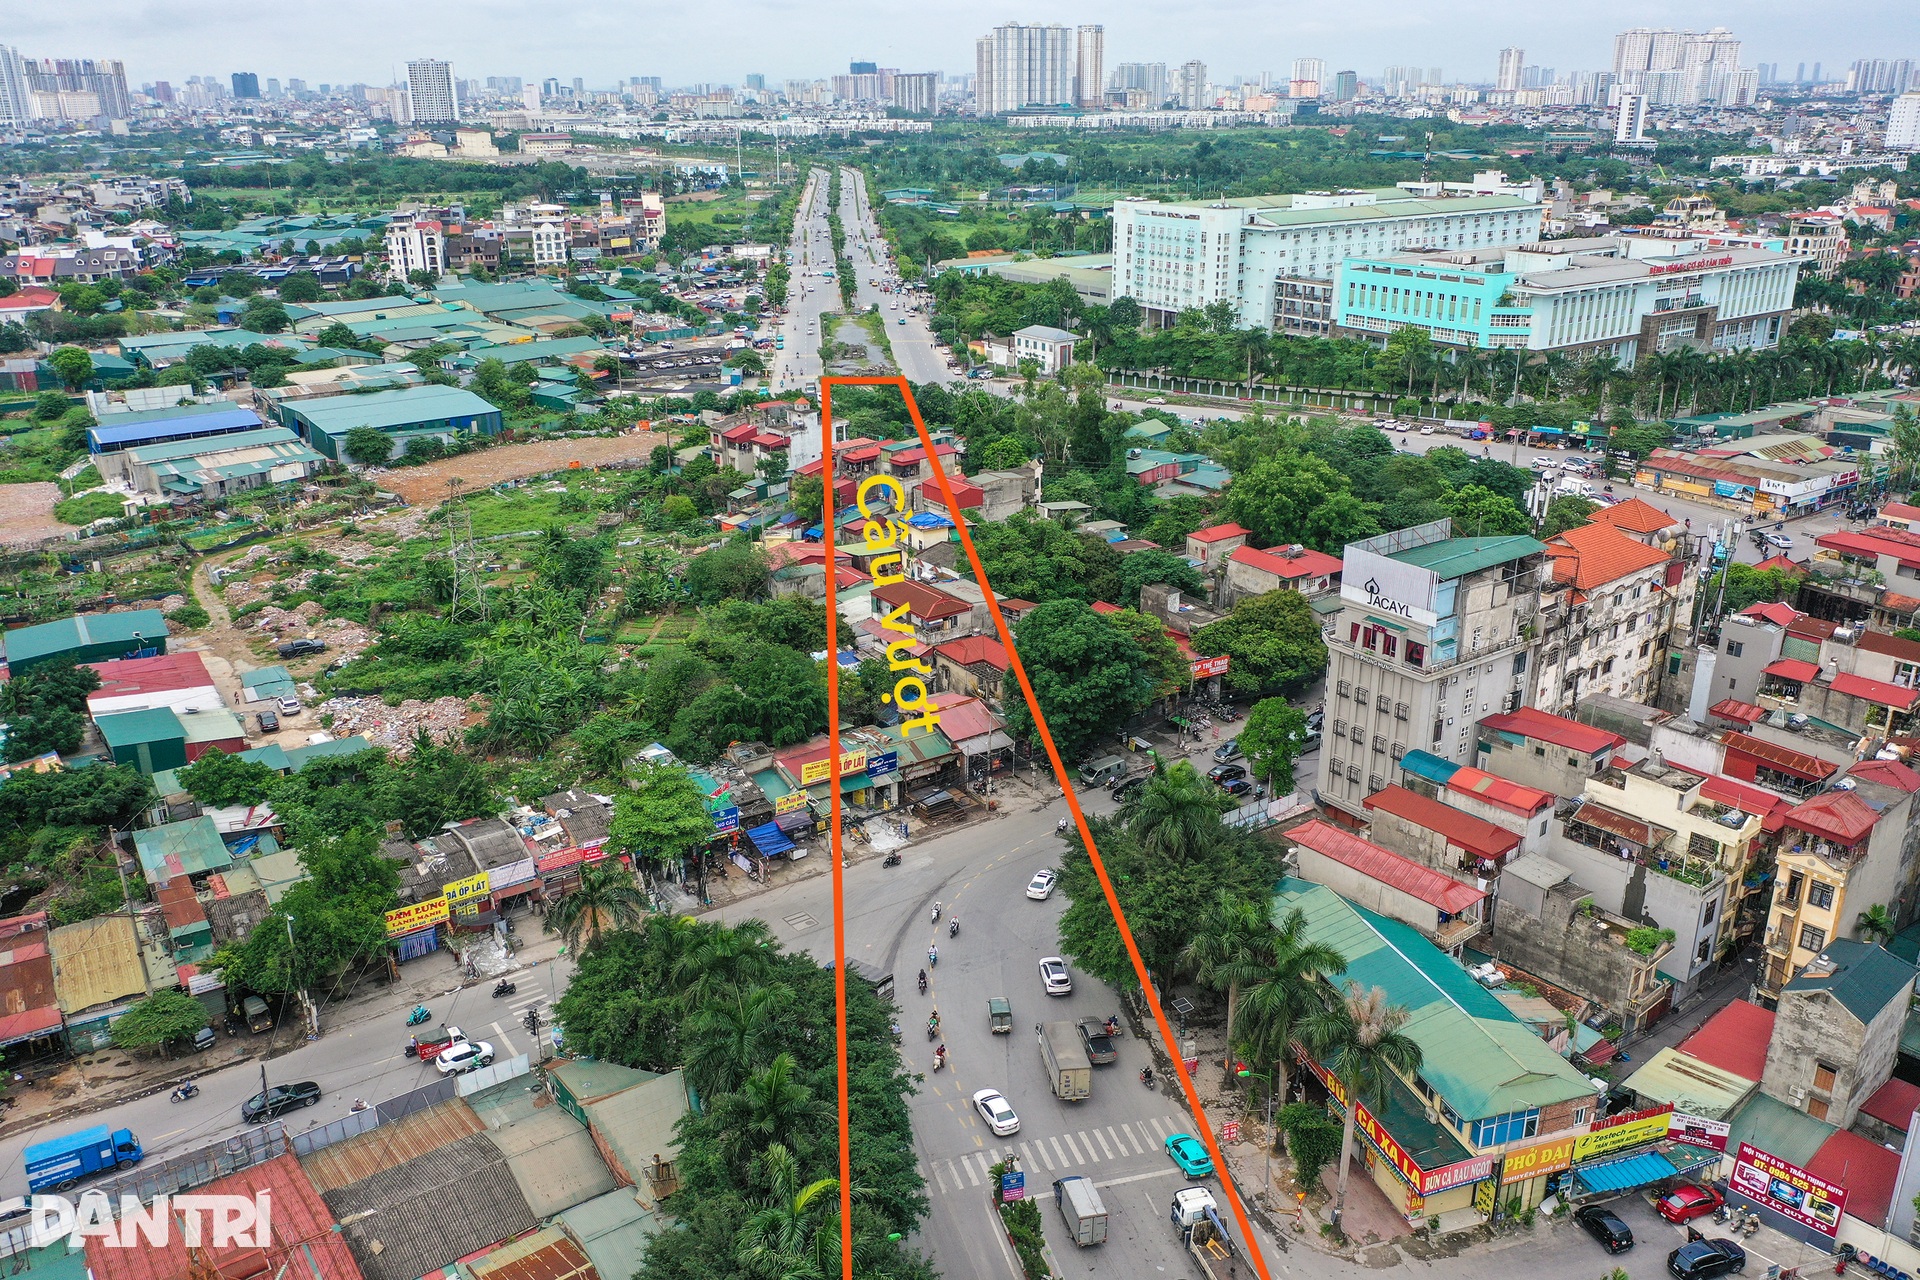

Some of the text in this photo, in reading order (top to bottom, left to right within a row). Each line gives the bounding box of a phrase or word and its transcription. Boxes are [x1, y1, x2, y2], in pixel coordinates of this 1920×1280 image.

[1365, 586, 1413, 619] JACAYL
[446, 889, 457, 900] ĐÁ
[472, 880, 486, 892] LÁT
[1357, 1108, 1376, 1139] CÁ
[1380, 1132, 1399, 1166] XA
[1403, 1158, 1420, 1190] LA
[1593, 1129, 1627, 1143] Zestech
[1678, 1134, 1713, 1146] GOTECH
[1424, 1171, 1441, 1192] BÚN
[1441, 1167, 1452, 1187] CÁ
[1452, 1165, 1470, 1183] RAU
[1470, 1157, 1491, 1177] NGÓT
[1503, 1147, 1538, 1173] PHỞ
[1540, 1143, 1572, 1164] ĐẠI
[1743, 1146, 1754, 1156] NỘI
[1755, 1150, 1770, 1163] THẤT
[1776, 1160, 1785, 1170] TÔ
[1789, 1166, 1807, 1181] TRẦN
[1826, 1183, 1844, 1197] AUTO
[1503, 1170, 1535, 1183] CHUYÊN
[1753, 1158, 1828, 1199] ĐT: 0984 525 136
[1737, 1185, 1754, 1198] ĐẠI
[1756, 1193, 1768, 1204] LÝ
[1784, 1208, 1804, 1220] QUY
[1814, 1220, 1828, 1232] TÔ
